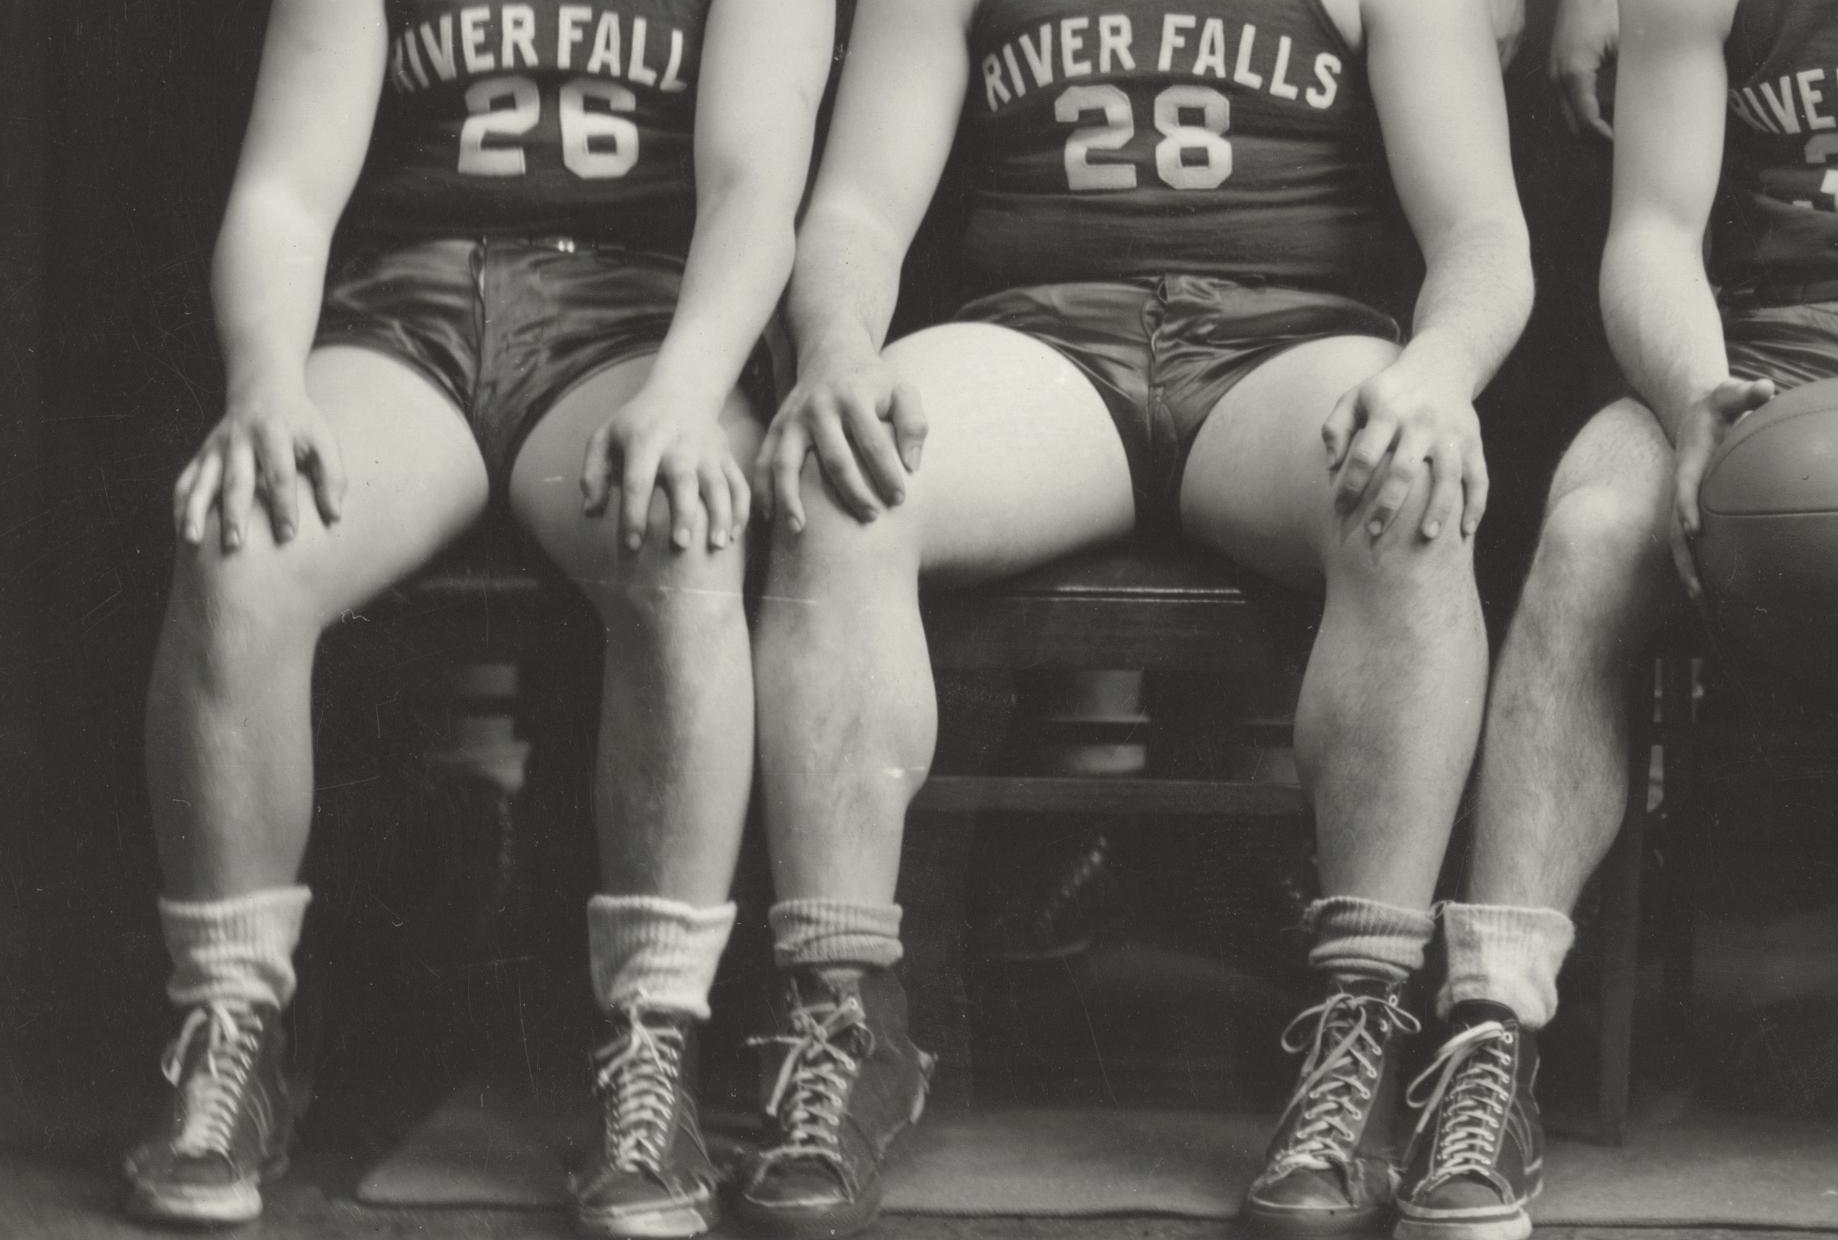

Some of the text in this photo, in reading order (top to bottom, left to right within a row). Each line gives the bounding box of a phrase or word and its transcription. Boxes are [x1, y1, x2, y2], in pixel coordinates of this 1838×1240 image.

[981, 13, 1342, 112] RIVER FALLS
[457, 74, 639, 179] 26
[1054, 83, 1233, 191] 28
